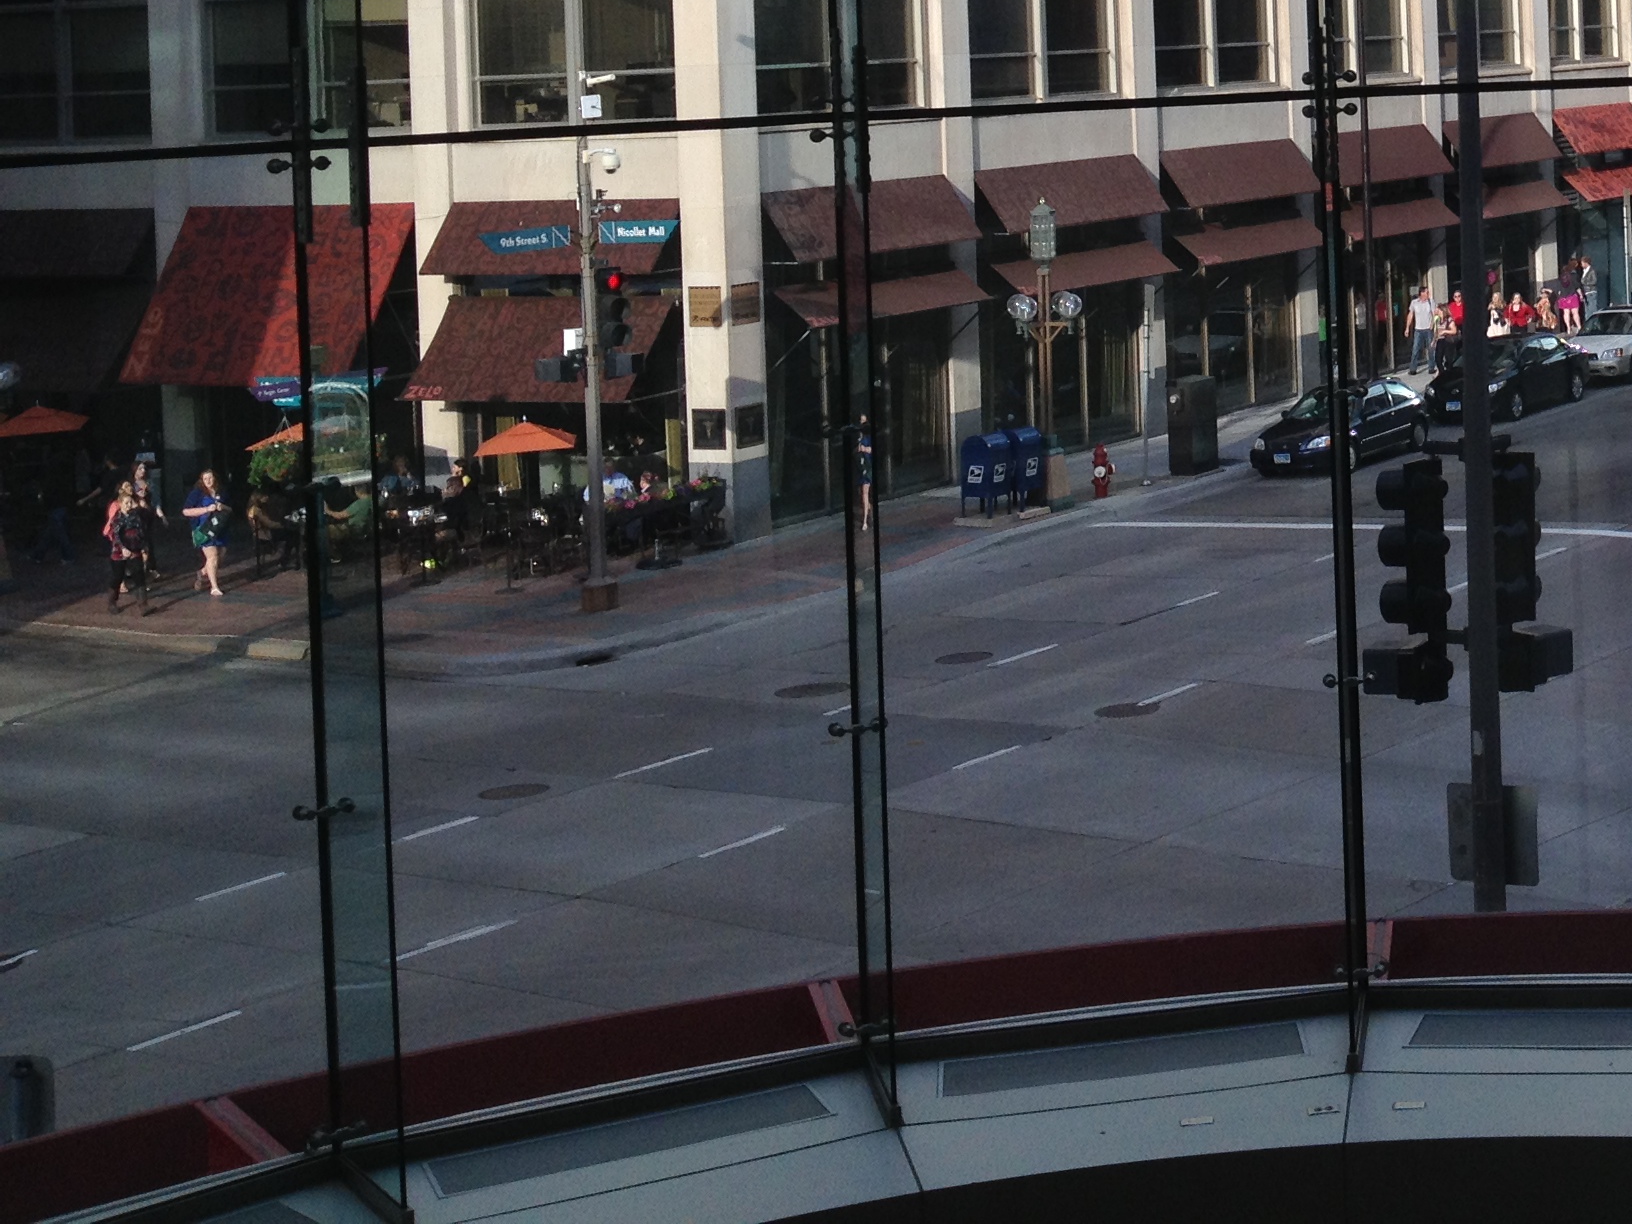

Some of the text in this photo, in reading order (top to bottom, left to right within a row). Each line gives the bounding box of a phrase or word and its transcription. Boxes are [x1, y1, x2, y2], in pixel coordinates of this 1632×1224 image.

[617, 226, 665, 237] Nicollet Mall
[500, 236, 515, 248] 9th
[515, 235, 540, 246] Street
